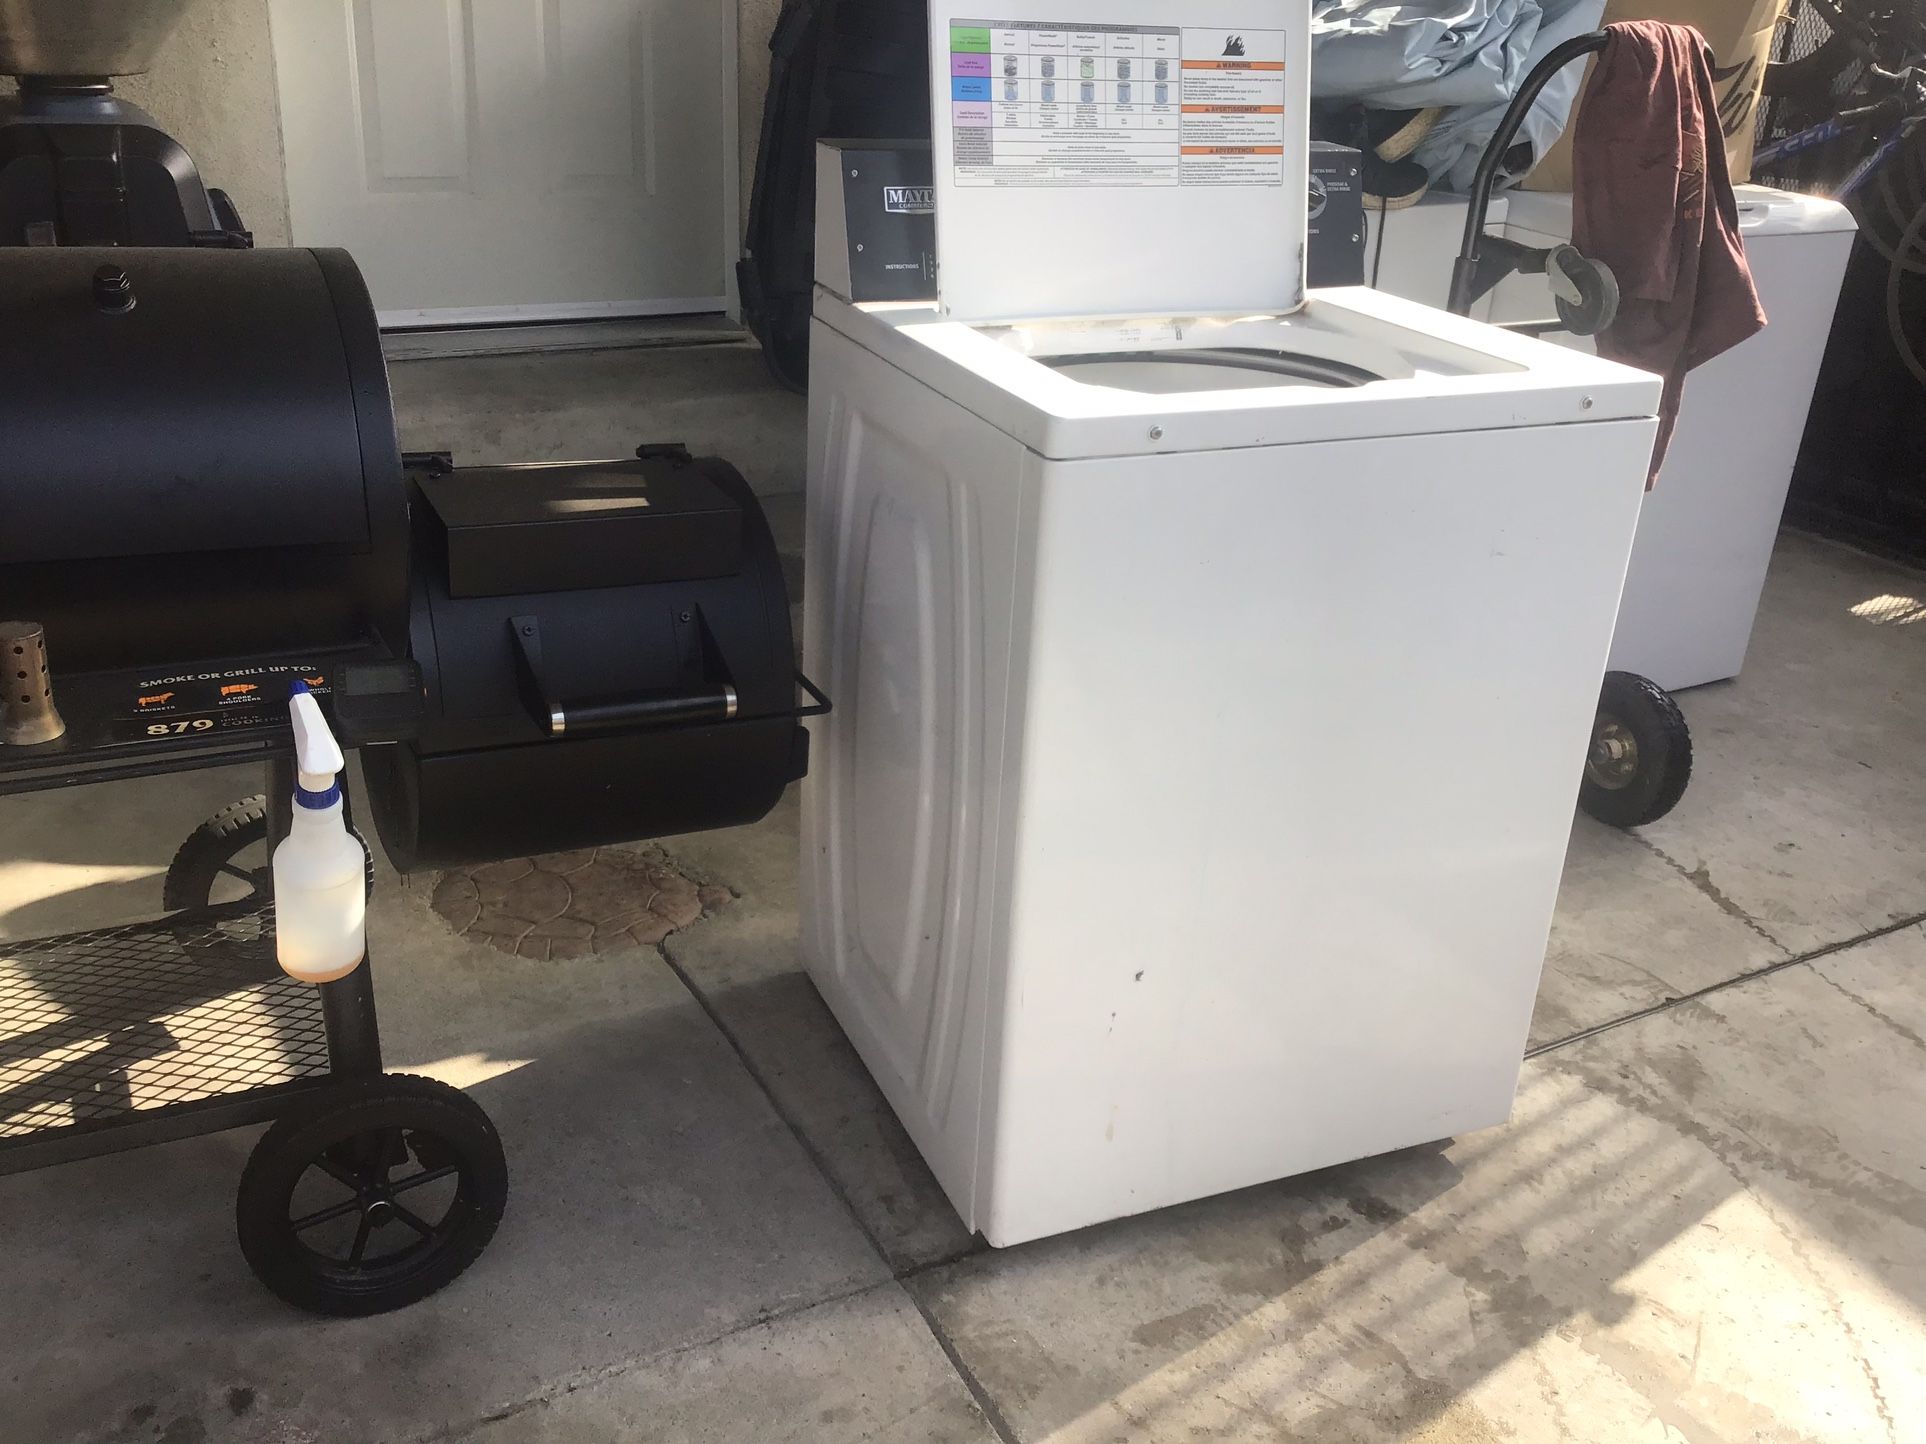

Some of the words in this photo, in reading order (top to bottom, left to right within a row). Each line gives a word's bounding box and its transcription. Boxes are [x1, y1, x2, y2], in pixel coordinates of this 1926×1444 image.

[139, 674, 195, 688] SMOKE
[198, 672, 221, 680] OR
[223, 666, 267, 677] GRILL
[146, 719, 214, 735] 879
